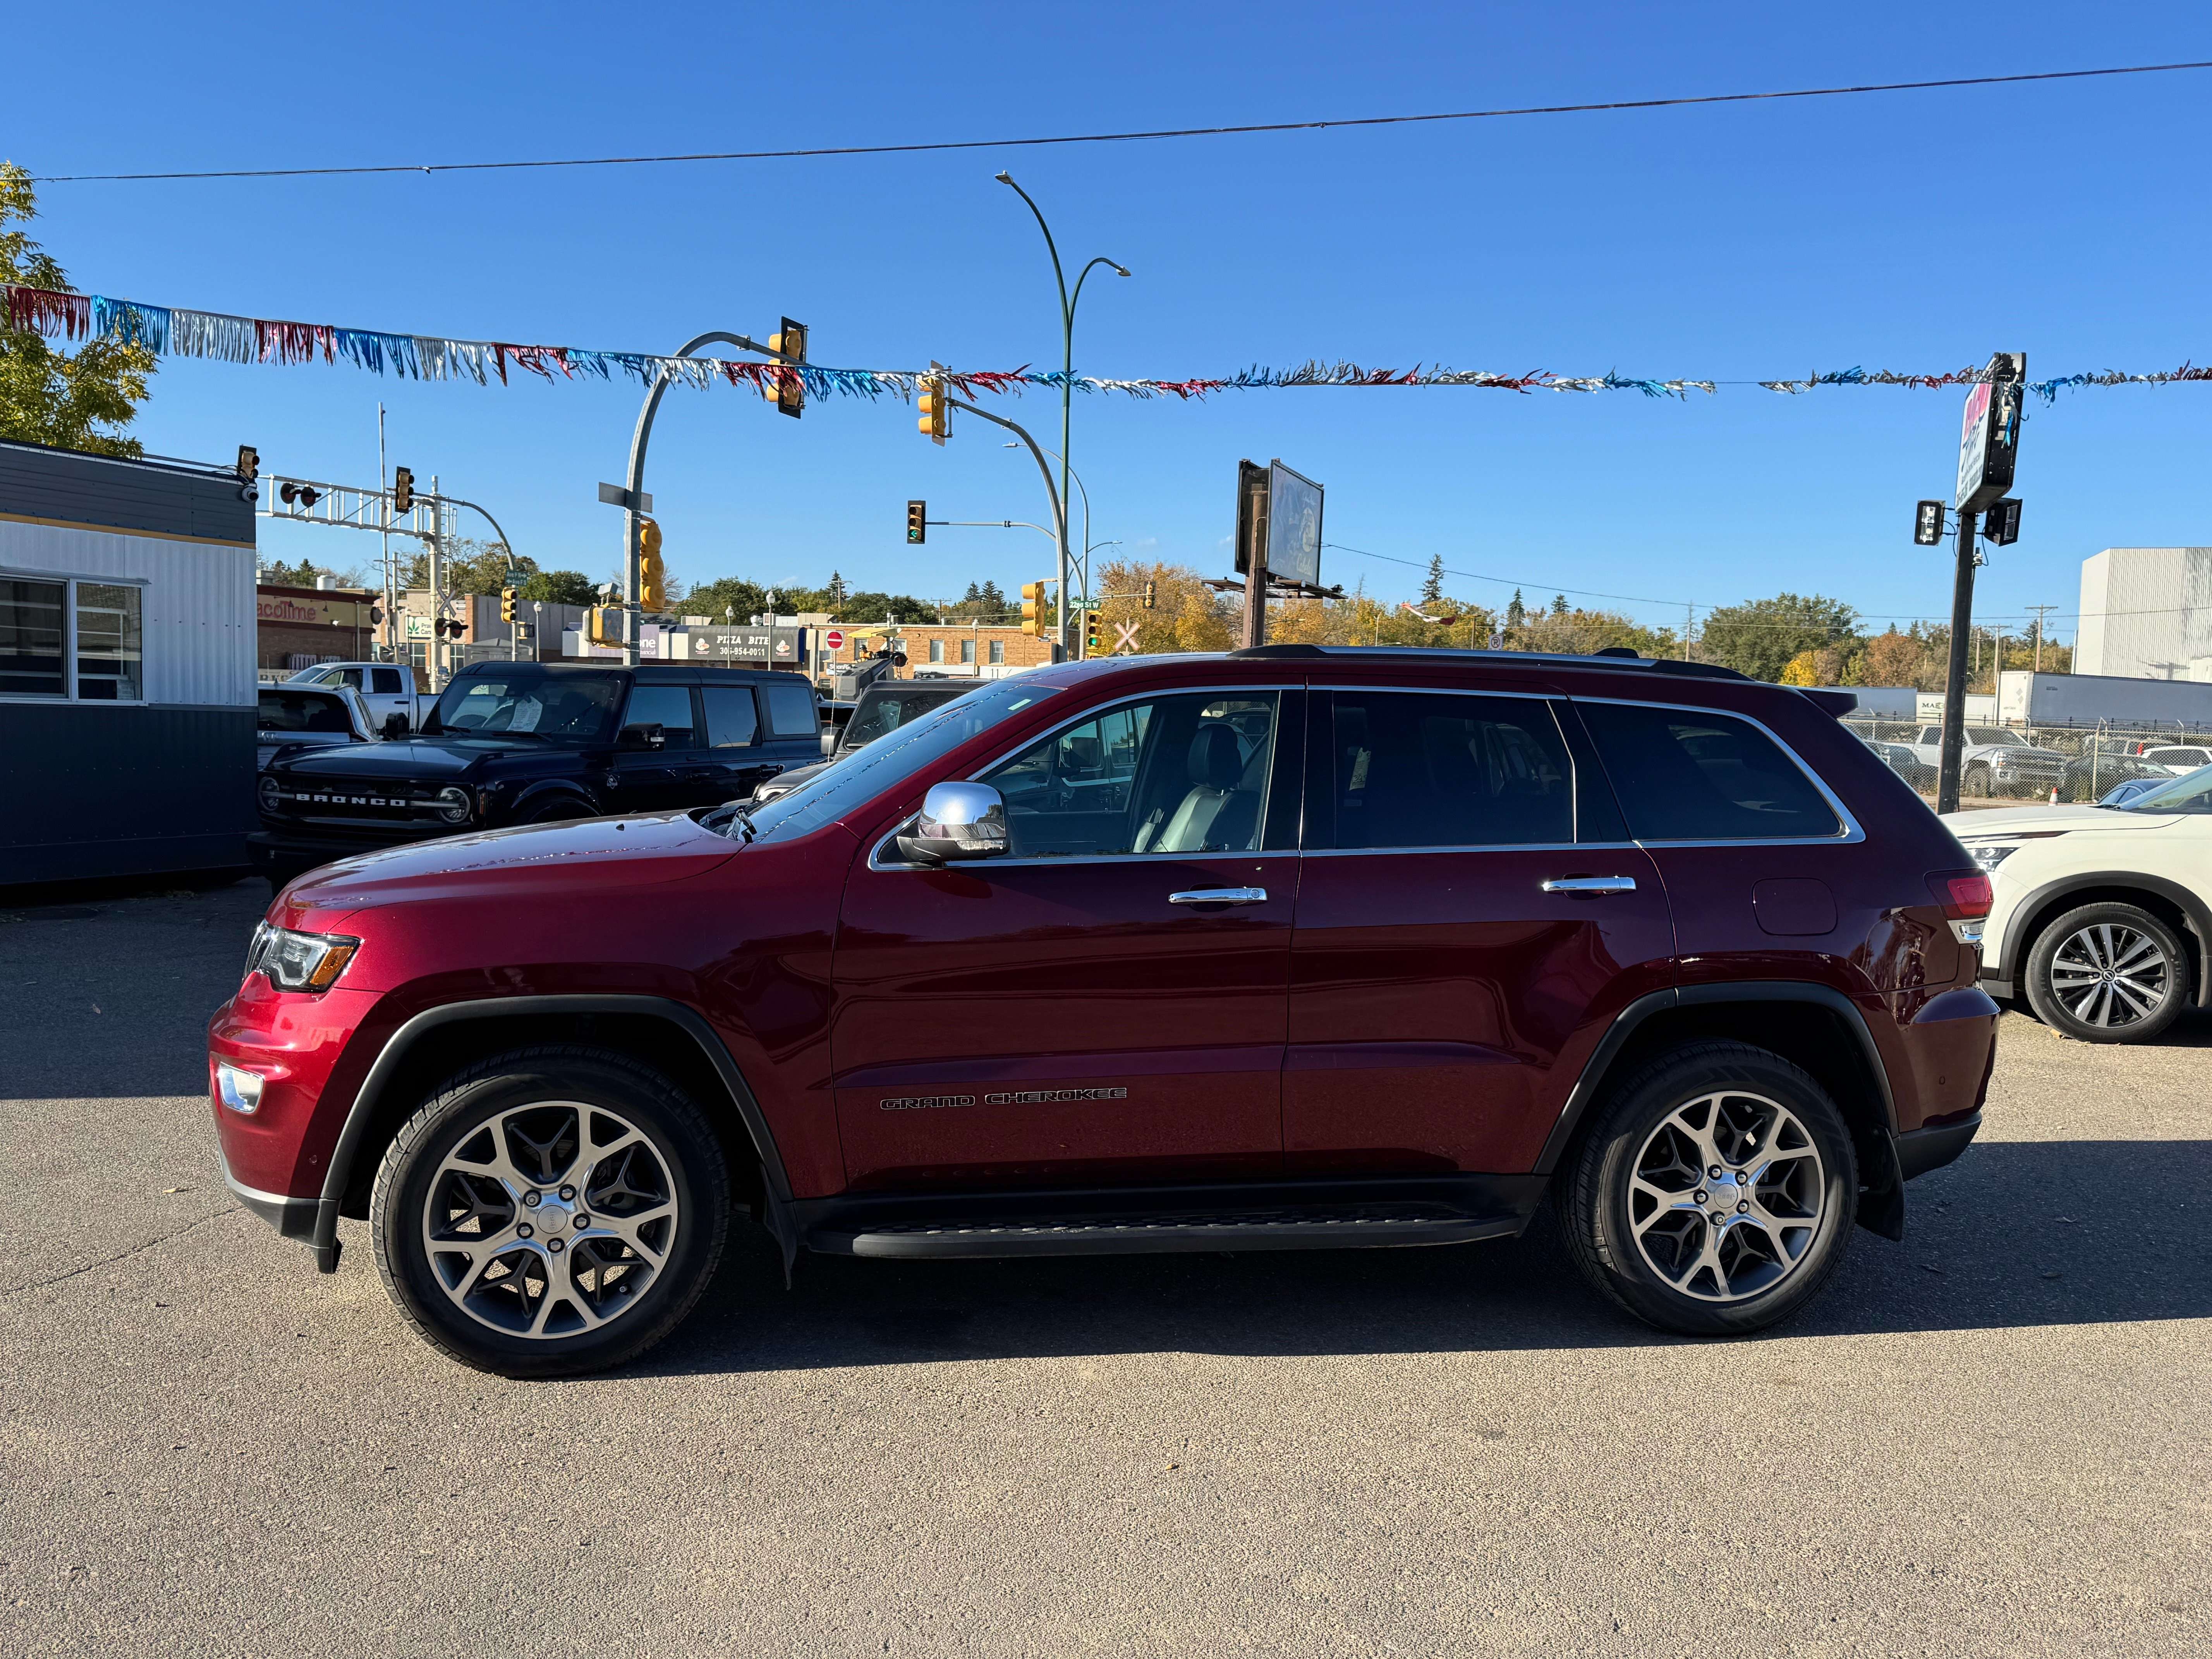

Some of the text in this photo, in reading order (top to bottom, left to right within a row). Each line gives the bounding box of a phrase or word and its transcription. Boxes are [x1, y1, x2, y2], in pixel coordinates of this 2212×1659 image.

[257, 601, 316, 620] acoTime
[748, 636, 769, 645] BITE
[296, 793, 406, 806] BRONCO
[880, 1087, 1127, 1109] GRAND CHEROKEE
